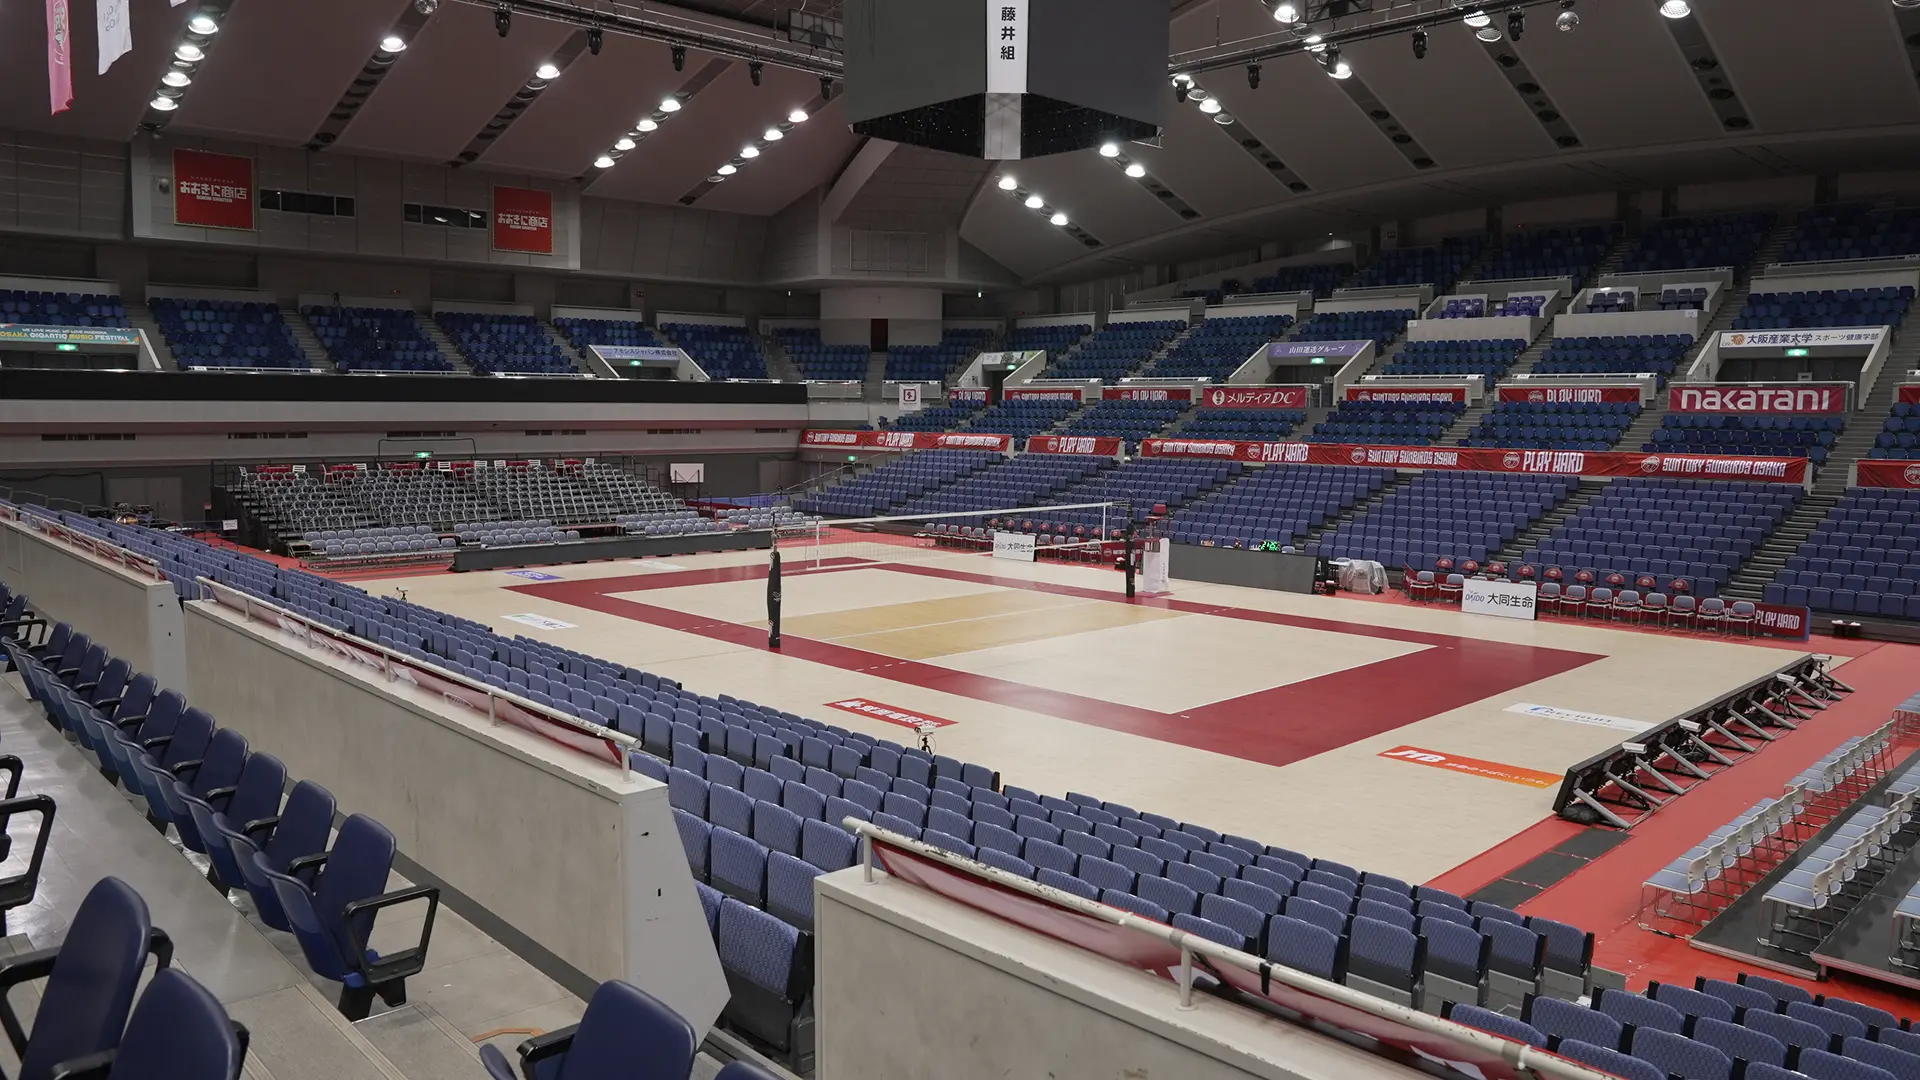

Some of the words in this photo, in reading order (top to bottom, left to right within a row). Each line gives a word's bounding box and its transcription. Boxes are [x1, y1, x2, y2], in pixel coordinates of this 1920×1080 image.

[1001, 6, 1016, 60] 藤井組
[180, 181, 248, 200] おおきに商店
[498, 213, 548, 228] おおきに商店
[1747, 332, 1813, 345] 大阪産業大学
[1814, 332, 1880, 342] スポーツ健康学部
[1289, 344, 1345, 354] 山田運送グループ
[1227, 391, 1296, 405] メルディアDC
[885, 432, 900, 447] PLAY
[1058, 436, 1077, 453] PLAY
[1077, 437, 1096, 453] HARD
[1262, 443, 1284, 461] PLAY
[1284, 444, 1309, 462] HARD
[1367, 449, 1398, 462] SUNTORY
[1399, 451, 1433, 465] SUNBIRDS
[1433, 452, 1458, 466] OSAKA
[1522, 451, 1552, 472] PLAY
[1553, 452, 1584, 473] HARD
[1662, 457, 1705, 473] SUNTORY
[1704, 459, 1751, 475] SUNBIRDS
[1752, 461, 1787, 477] OSAKA
[1487, 593, 1534, 608] 大同生命
[1755, 609, 1777, 627] PLAY
[1776, 612, 1800, 629] HARD
[1384, 750, 1446, 763] JTB
